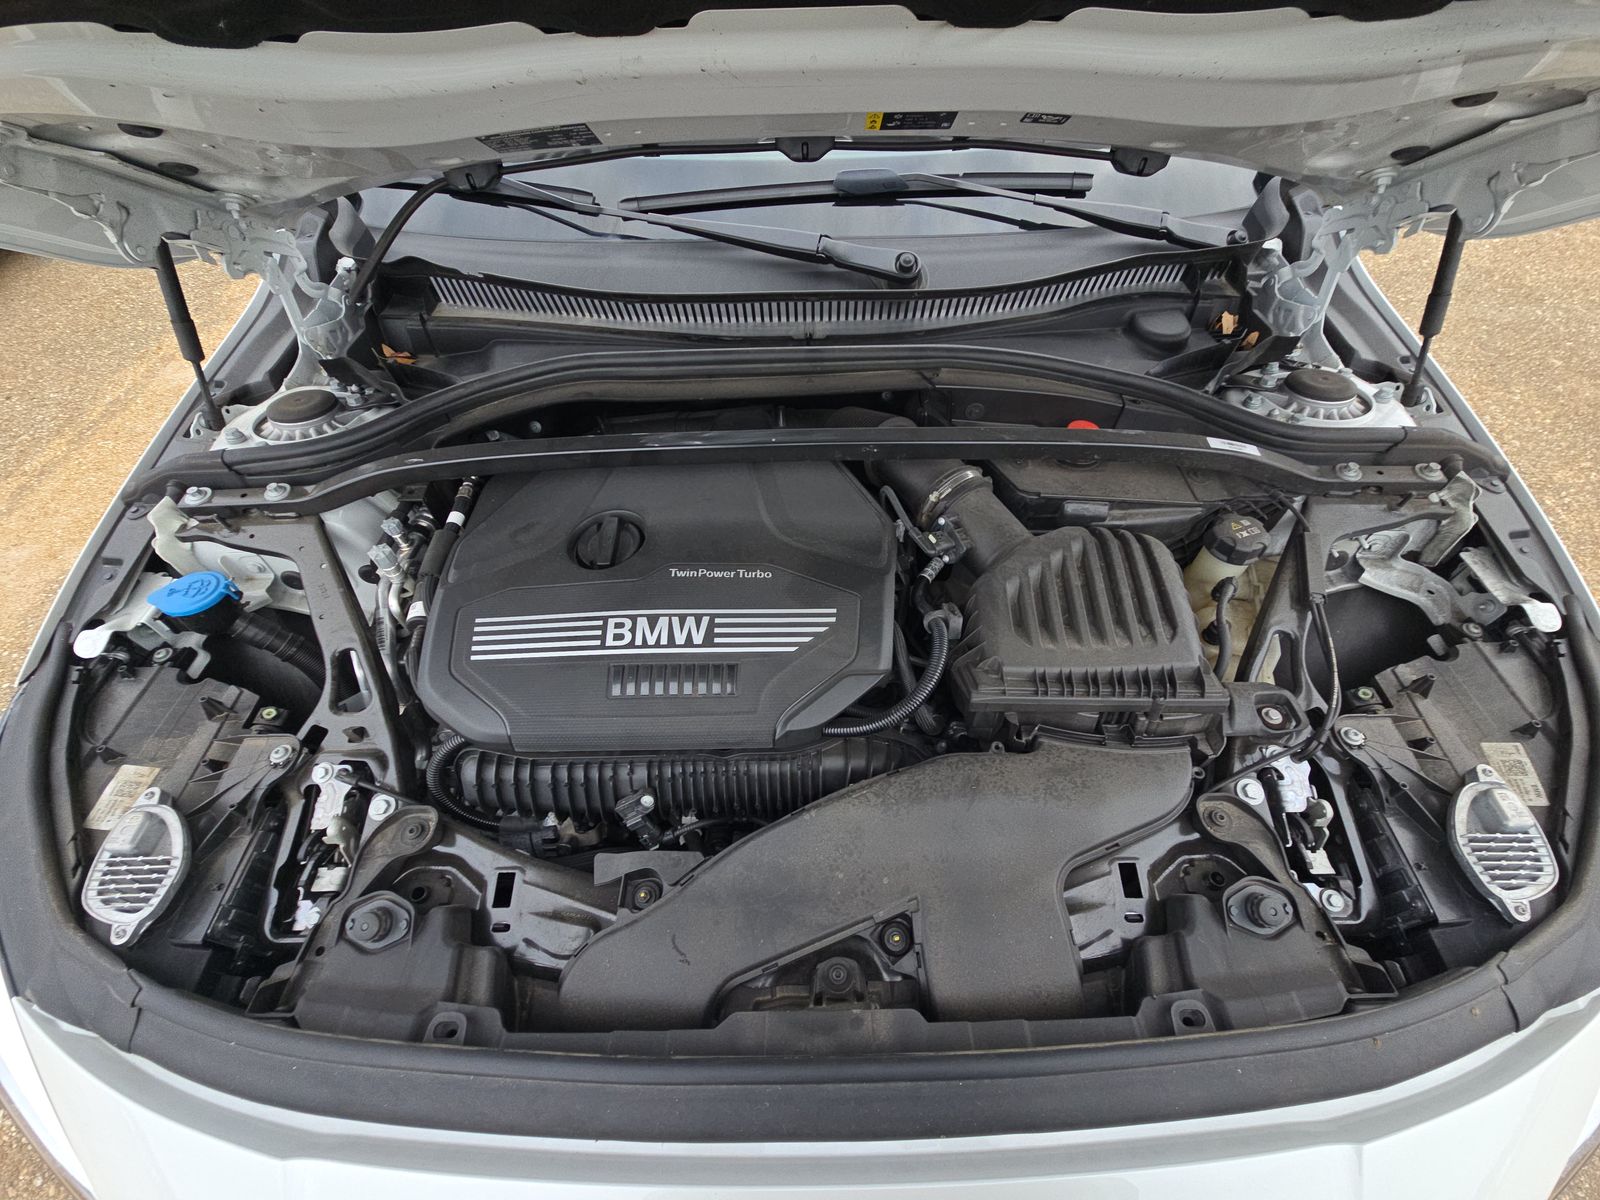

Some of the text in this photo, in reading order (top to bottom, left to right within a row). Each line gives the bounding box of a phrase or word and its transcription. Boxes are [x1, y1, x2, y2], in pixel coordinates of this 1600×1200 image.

[669, 568, 772, 578] TwinPower Turbo
[605, 616, 710, 647] BMW
